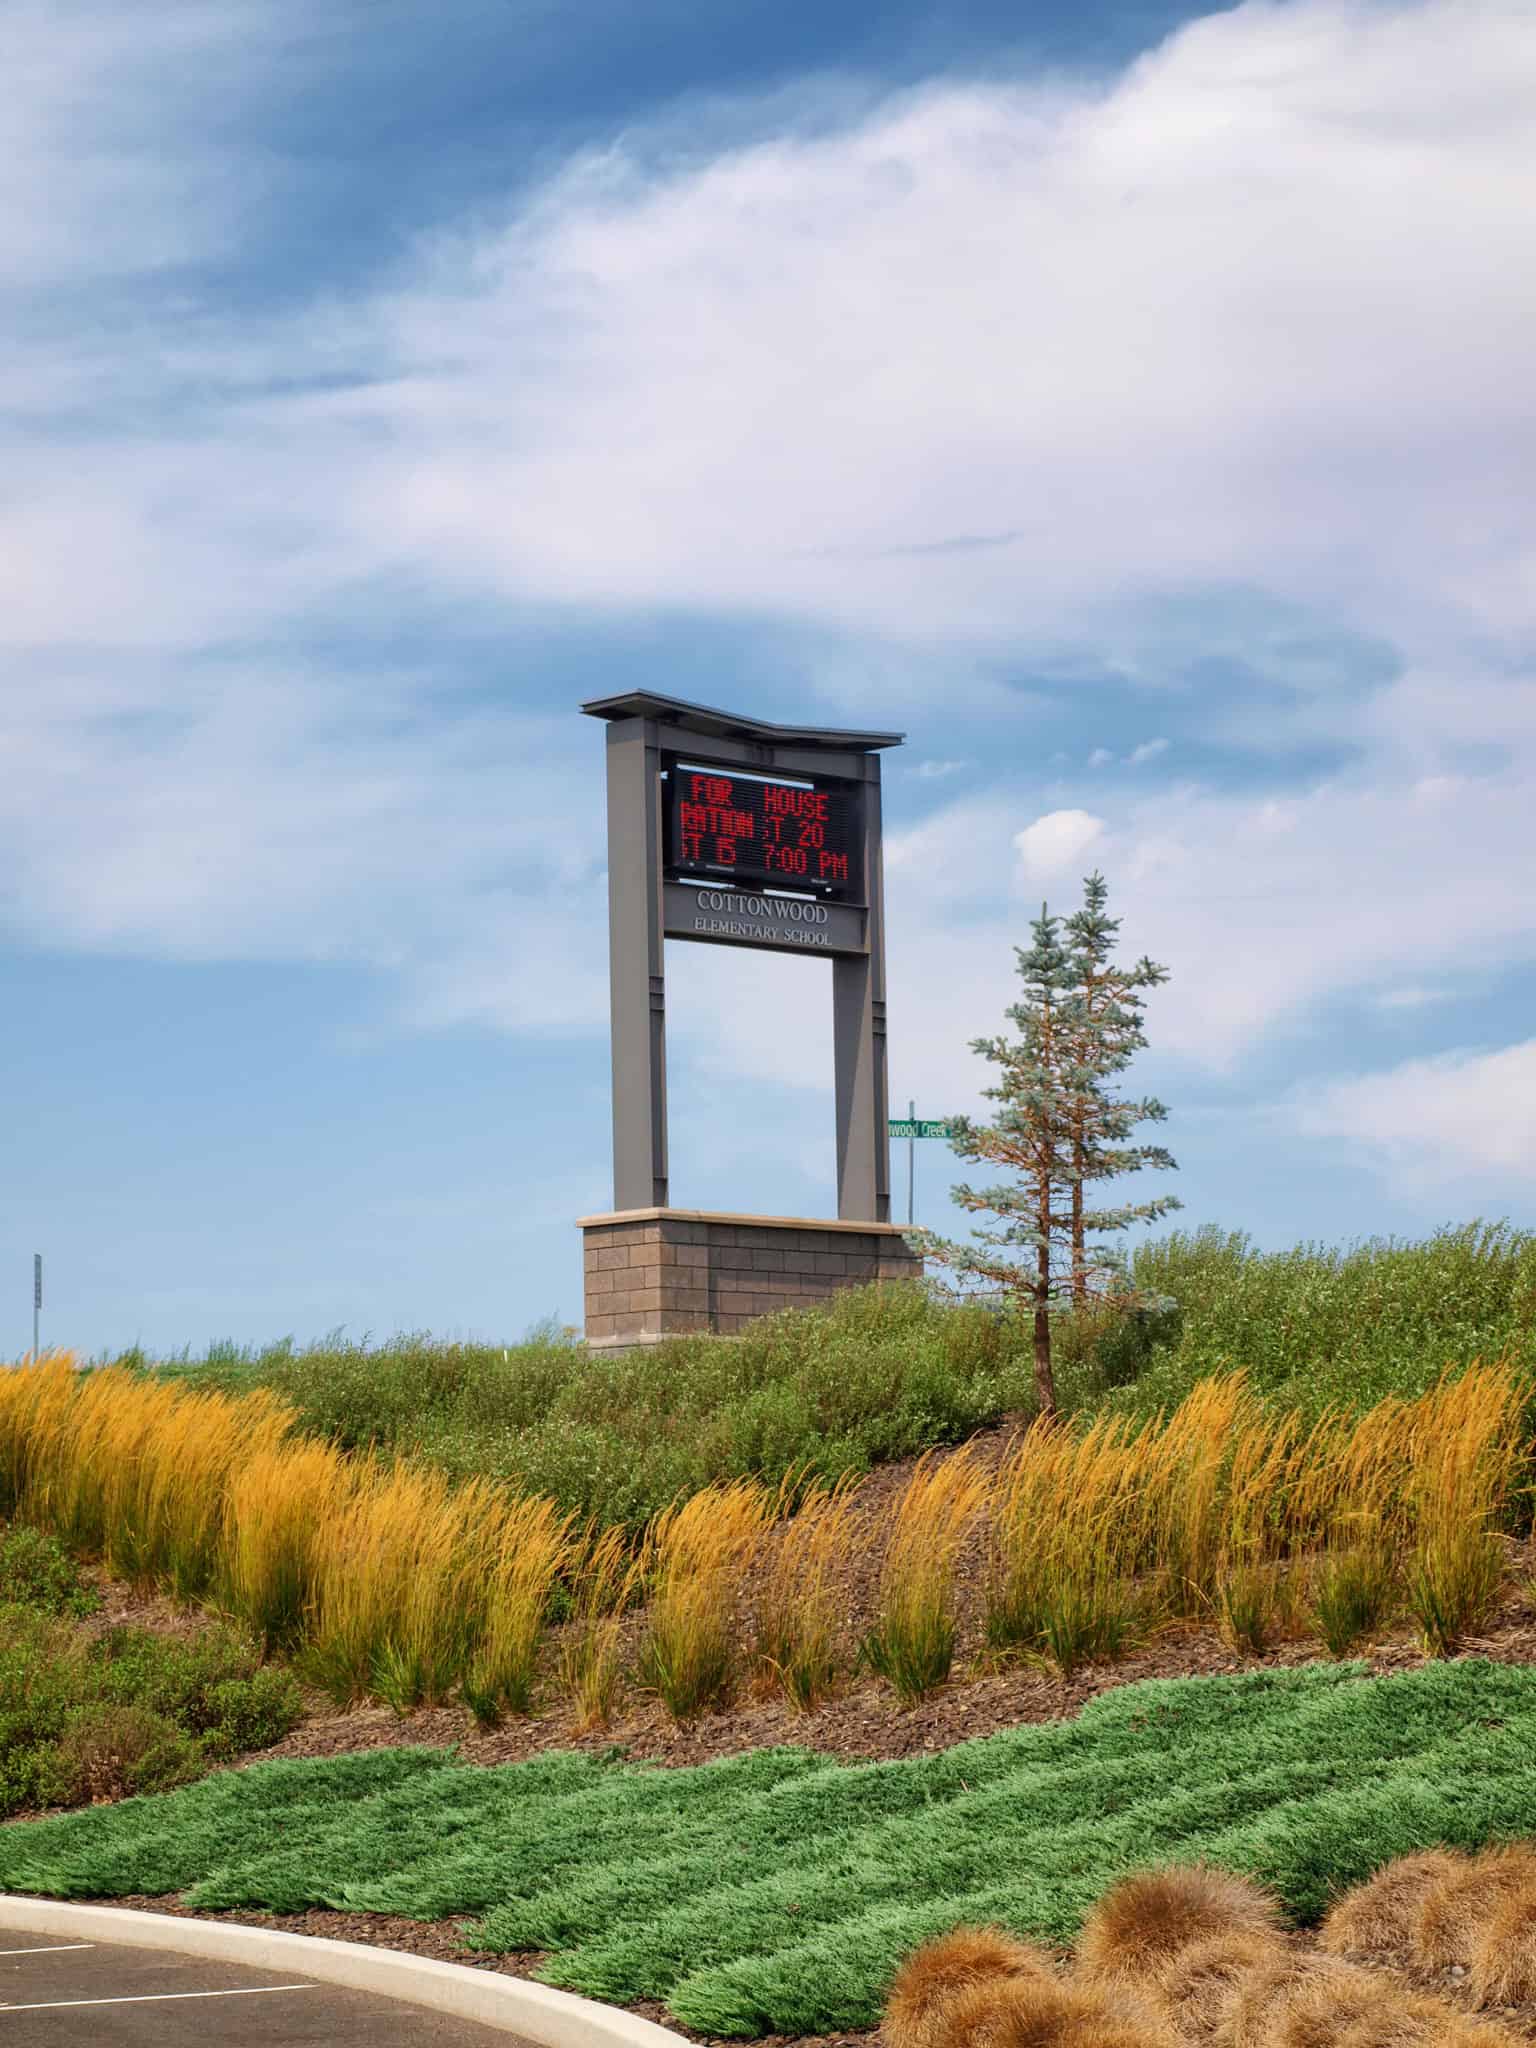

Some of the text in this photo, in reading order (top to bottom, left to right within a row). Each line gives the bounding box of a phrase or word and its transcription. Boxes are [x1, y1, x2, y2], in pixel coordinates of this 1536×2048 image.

[690, 775, 733, 806] FOR
[764, 786, 829, 821] HOUSE
[799, 821, 825, 848] 20
[763, 844, 848, 880] 7:00 PM
[697, 890, 828, 923] COTTONWOOD
[694, 917, 832, 945] ELEMENTARY SCHOOL
